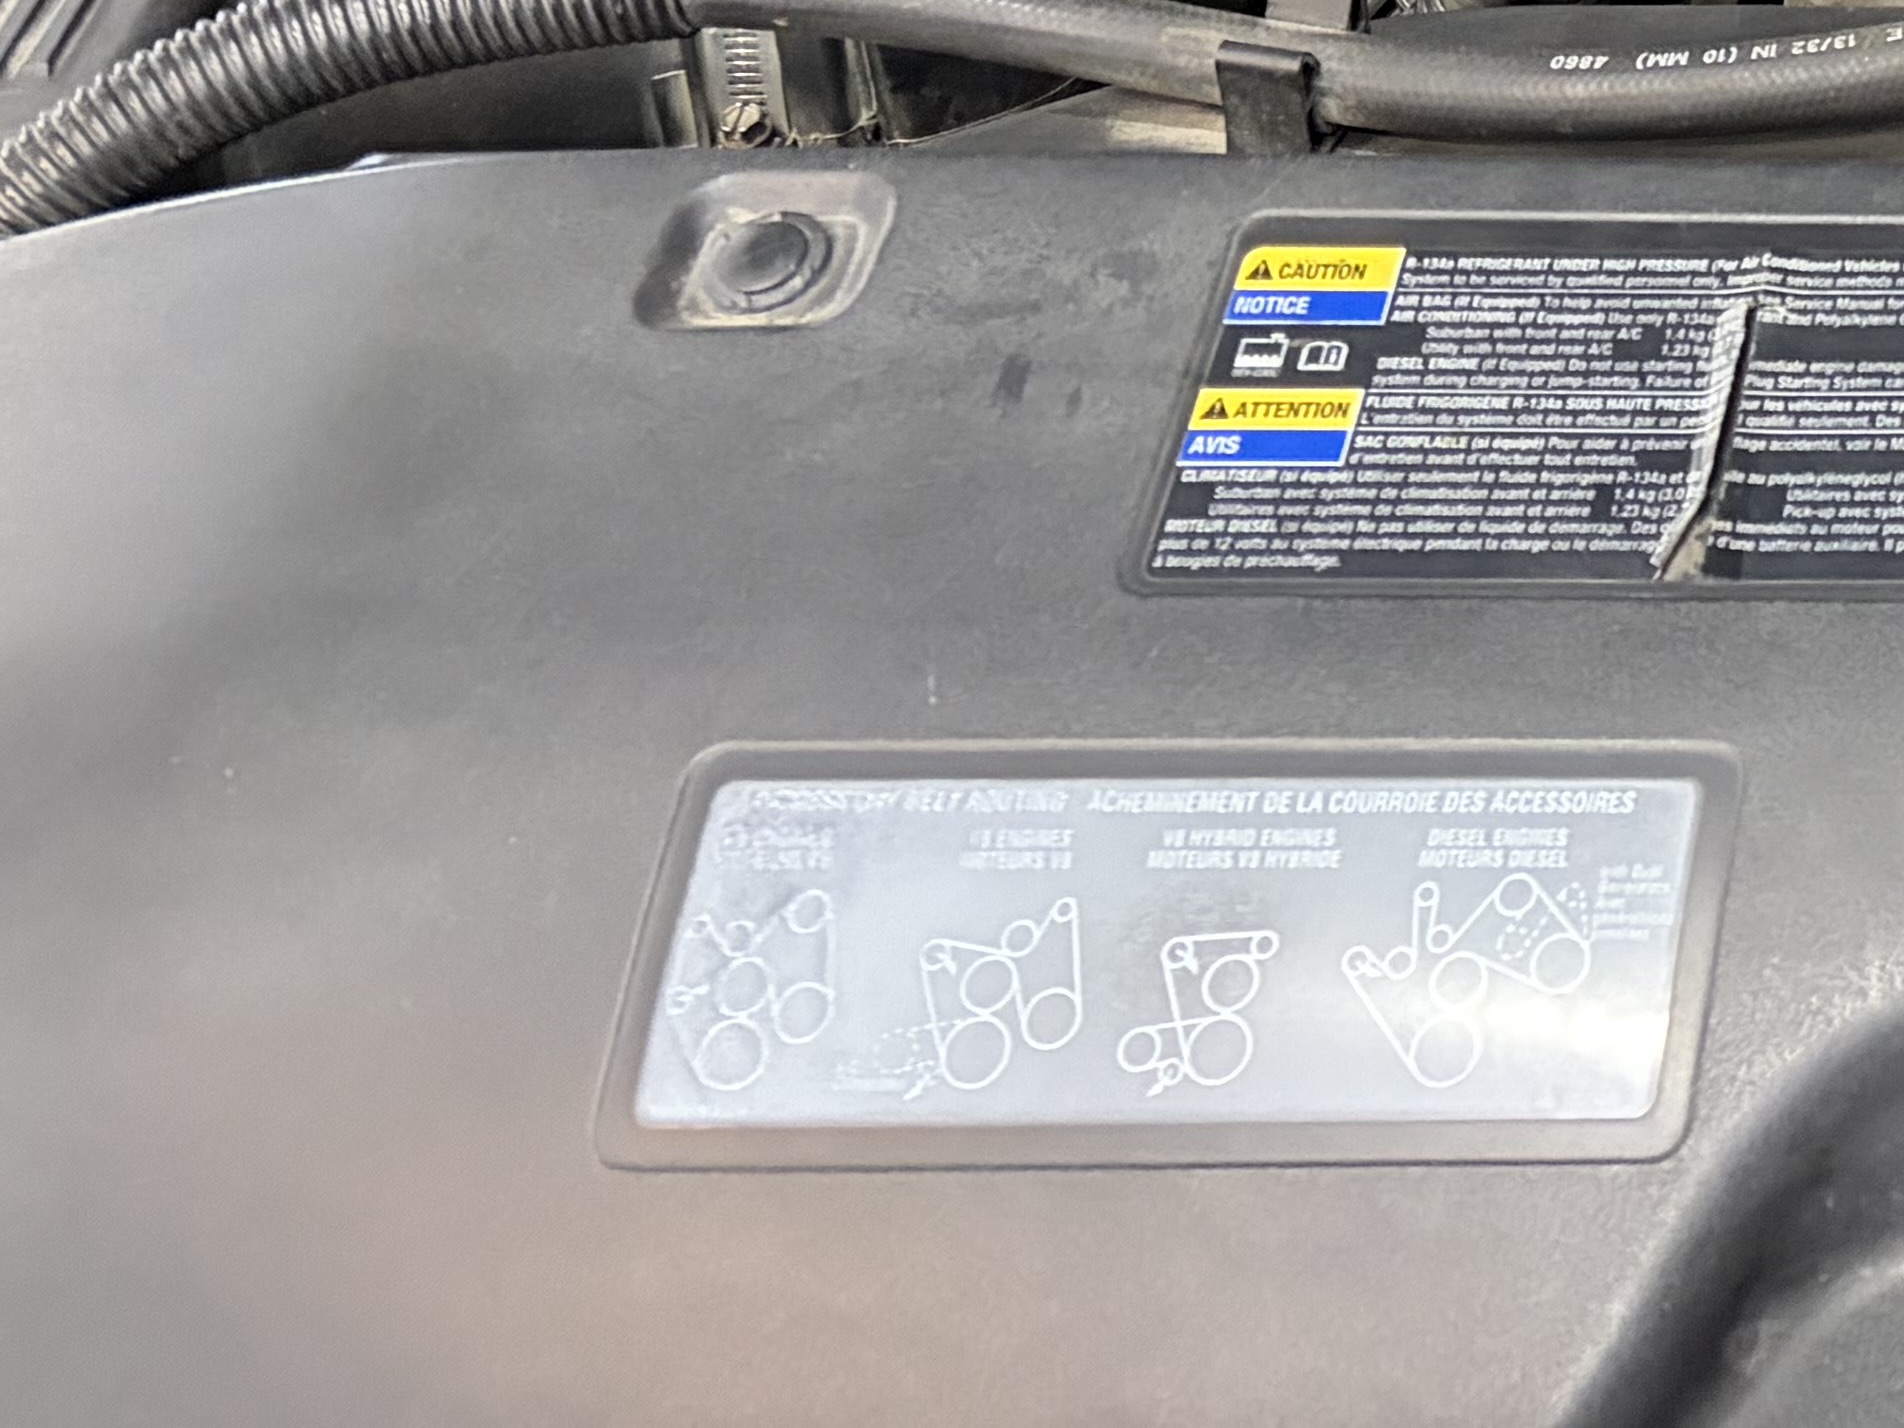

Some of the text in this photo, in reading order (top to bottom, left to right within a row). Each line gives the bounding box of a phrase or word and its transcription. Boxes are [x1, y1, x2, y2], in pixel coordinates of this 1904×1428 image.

[1750, 42, 1779, 59] IN
[1790, 32, 1857, 56] 13/32
[1635, 49, 1690, 70] MM)
[1702, 44, 1739, 65] (10
[1278, 260, 1368, 282] CAUTION
[1405, 255, 1455, 269] R-134a
[1457, 256, 1550, 270] REFRIGERANT
[1552, 258, 1600, 271] UNDER
[1602, 258, 1636, 271] HIGH
[1637, 259, 1709, 272] PRESSURE
[1232, 296, 1309, 315] NOTICE
[1233, 401, 1351, 419] ATTENTION
[1365, 395, 1415, 408] FLUIDE
[1512, 396, 1563, 409] R-134a
[1565, 396, 1604, 409] SOUS
[1606, 396, 1656, 409] HAUTE
[1187, 436, 1240, 456] AVIS
[1261, 790, 1292, 813] DE
[1295, 790, 1325, 813] LA
[1328, 790, 1440, 813] COURROIE
[1443, 790, 1487, 813] DES
[1490, 790, 1639, 813] ACCESSOIRES
[1189, 828, 1256, 846] HYBRID
[1260, 827, 1338, 846] ENGINES
[1425, 827, 1567, 846] DIESEL ENGINES
[1147, 849, 1234, 867] MOTEURS
[1264, 849, 1342, 867] HYBRIDE
[1418, 848, 1570, 866] MOTEURS DIESEL
